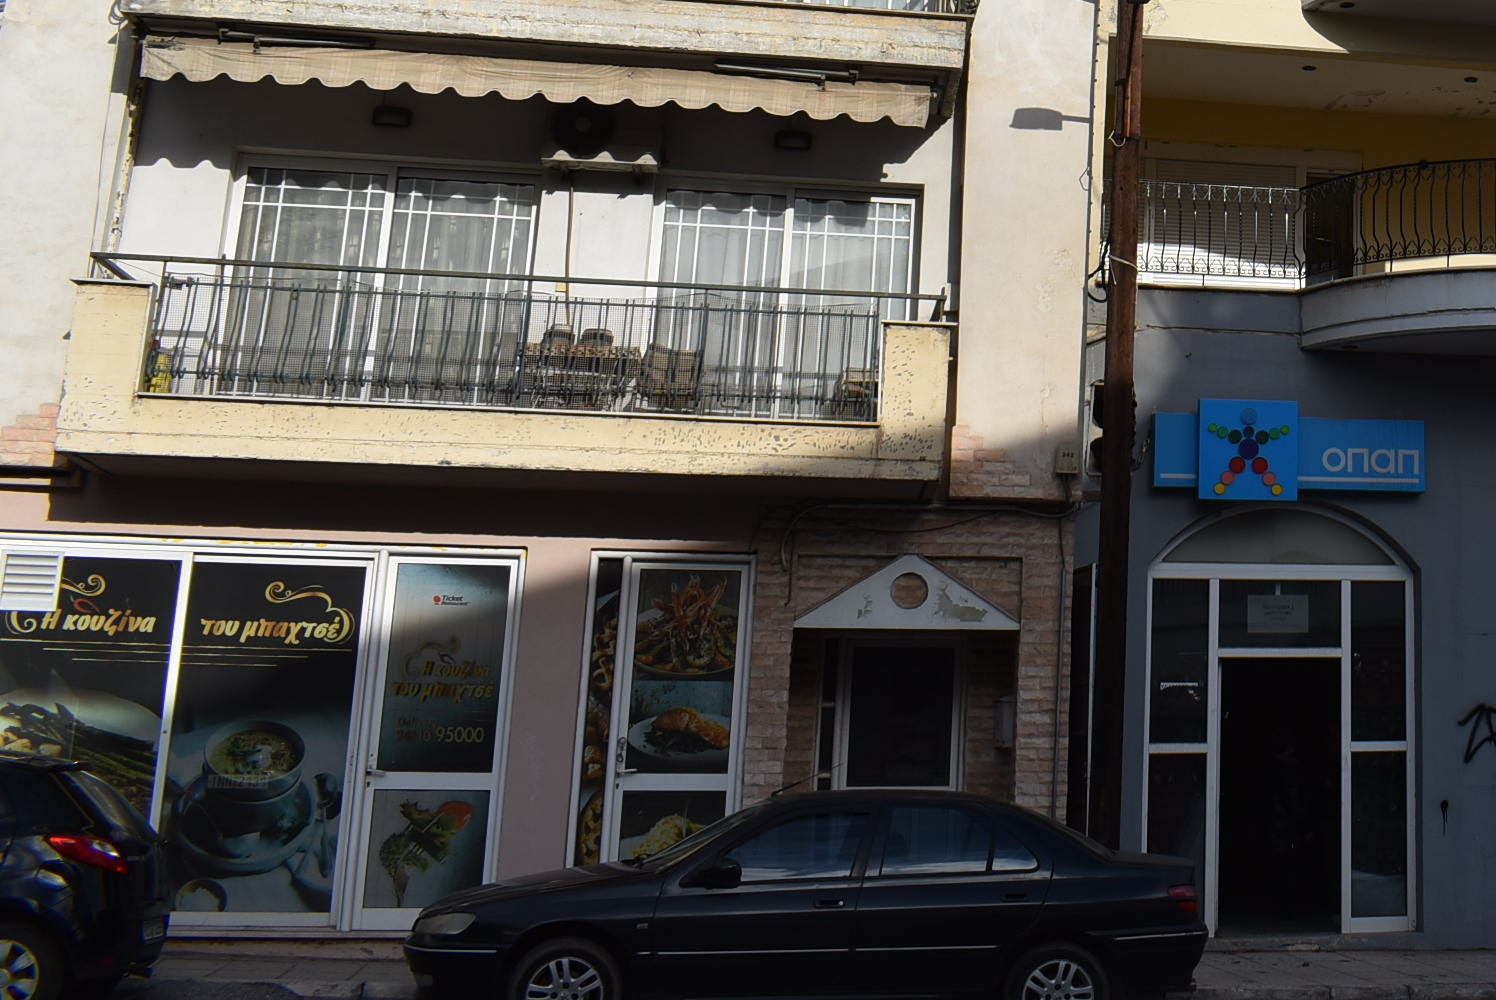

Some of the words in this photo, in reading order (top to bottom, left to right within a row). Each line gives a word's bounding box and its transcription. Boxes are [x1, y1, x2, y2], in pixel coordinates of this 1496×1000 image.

[63, 608, 157, 637] κουζίνα
[200, 617, 239, 637] του
[239, 615, 342, 644] μπαχτσέ
[436, 726, 485, 743] 95000
